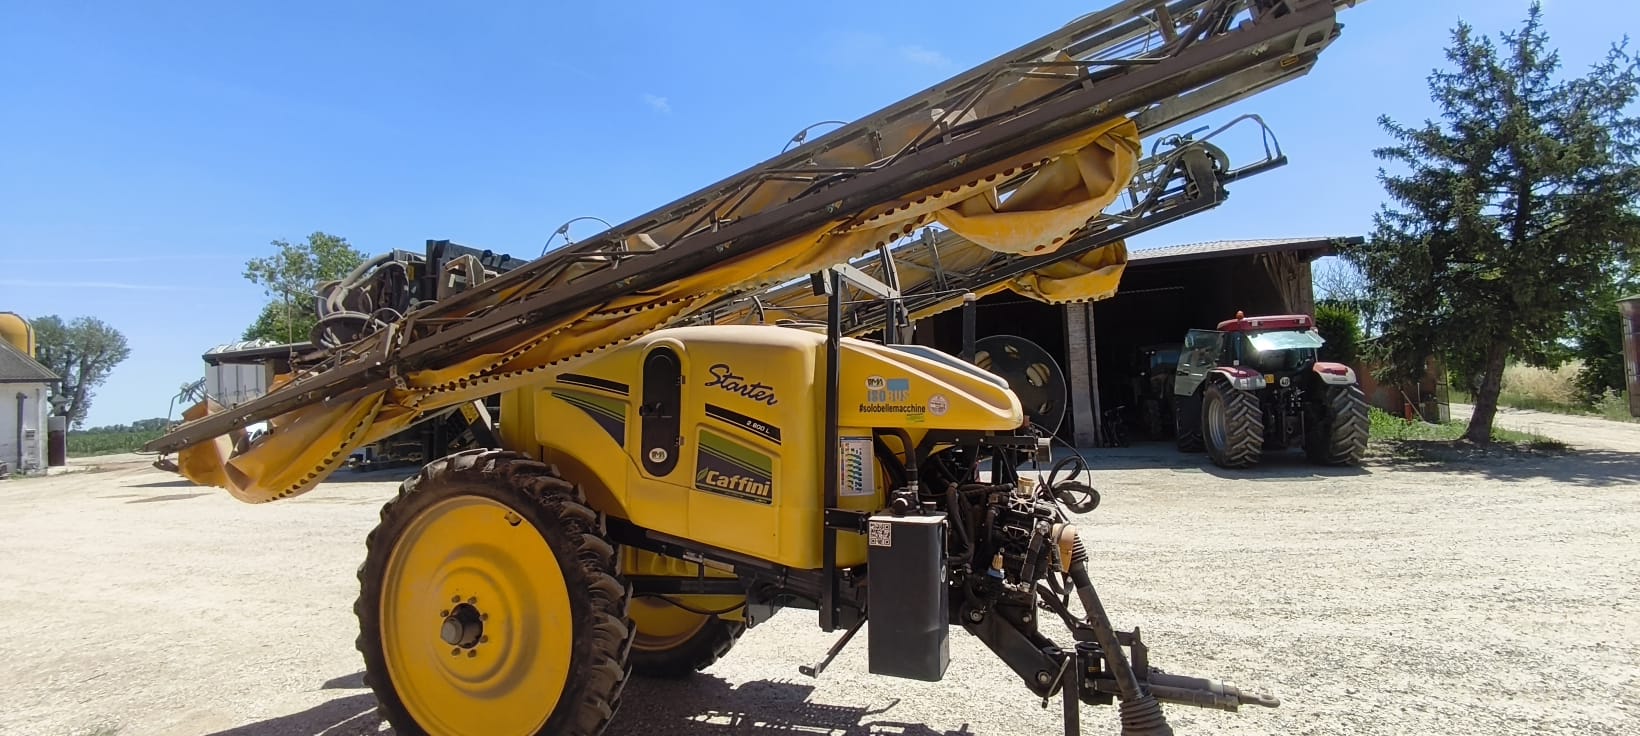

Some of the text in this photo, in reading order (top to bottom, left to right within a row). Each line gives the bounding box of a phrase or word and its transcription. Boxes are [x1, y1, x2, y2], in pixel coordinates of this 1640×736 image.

[704, 363, 778, 406] Starter
[859, 403, 926, 413] #solobellemacchine
[705, 470, 771, 497] Caffini
